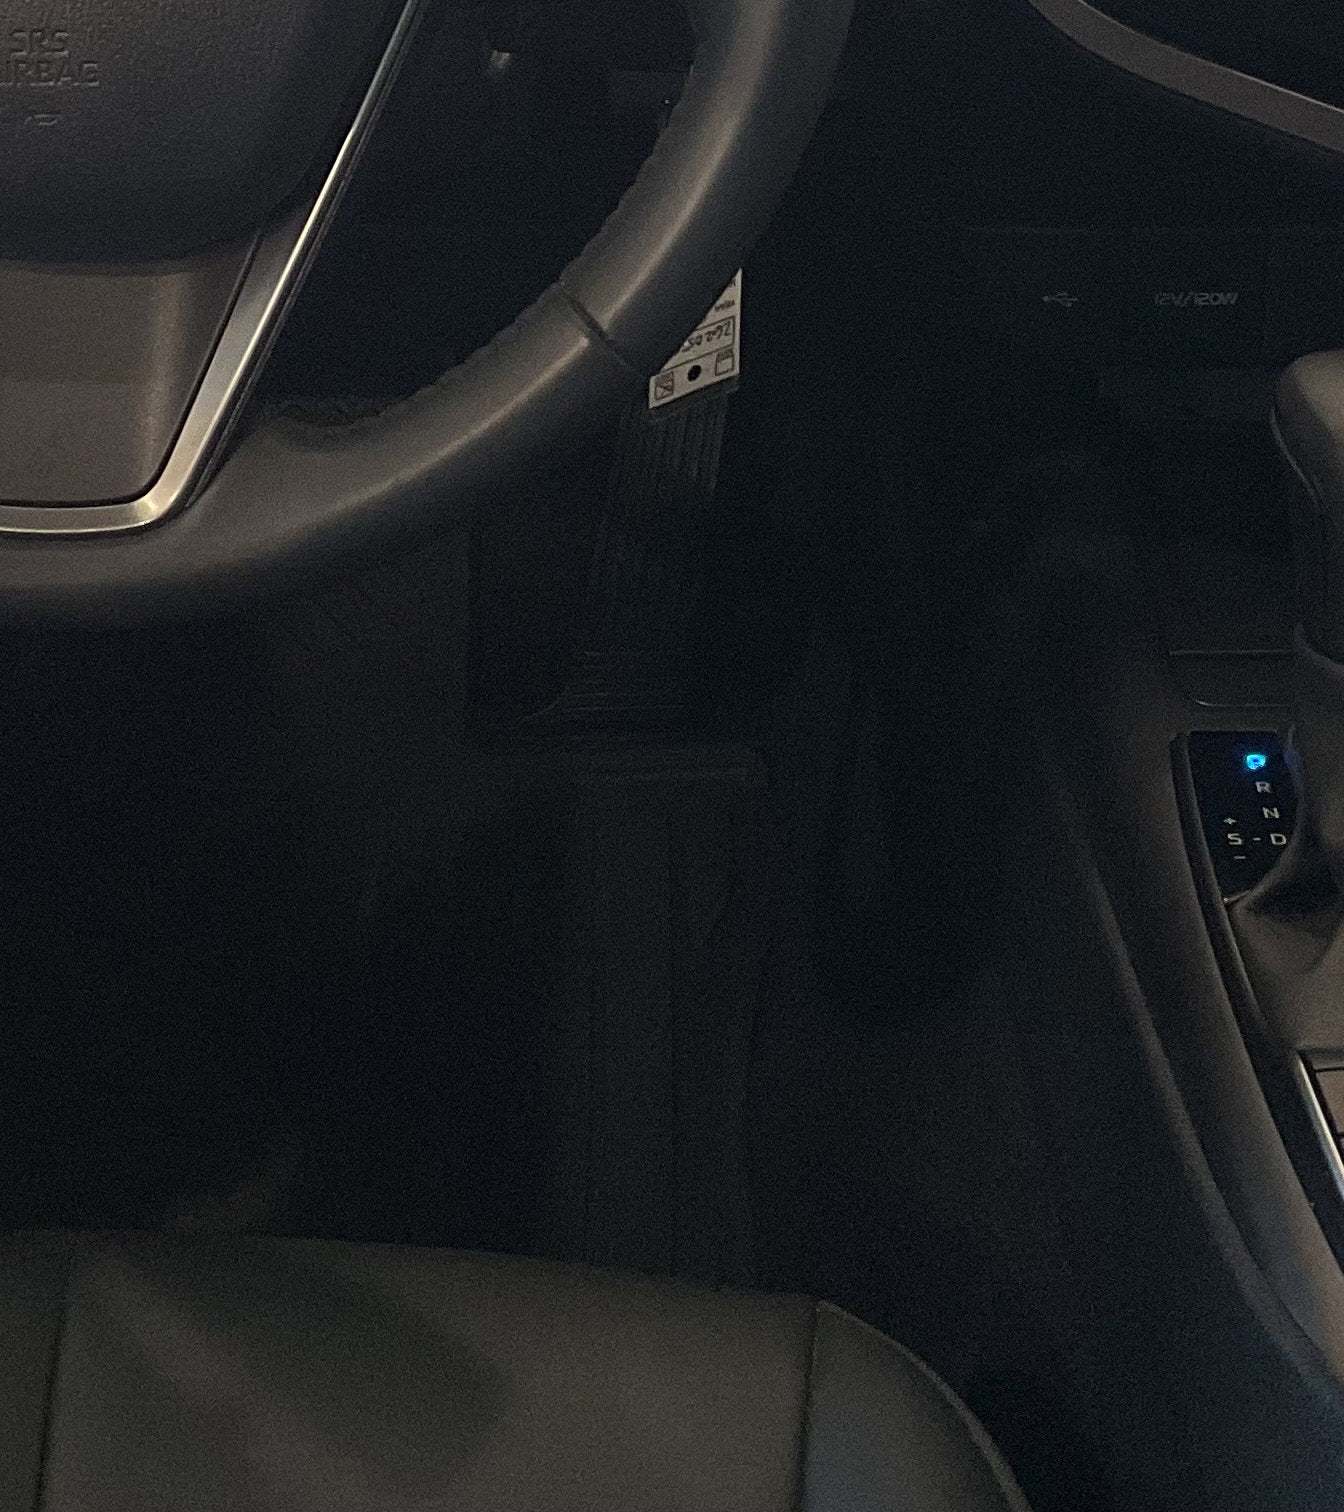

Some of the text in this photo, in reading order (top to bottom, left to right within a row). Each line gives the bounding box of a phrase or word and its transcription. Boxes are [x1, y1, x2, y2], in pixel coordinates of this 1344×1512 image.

[1255, 780, 1272, 794] R
[1262, 806, 1280, 819] N
[1226, 832, 1287, 846] S D
